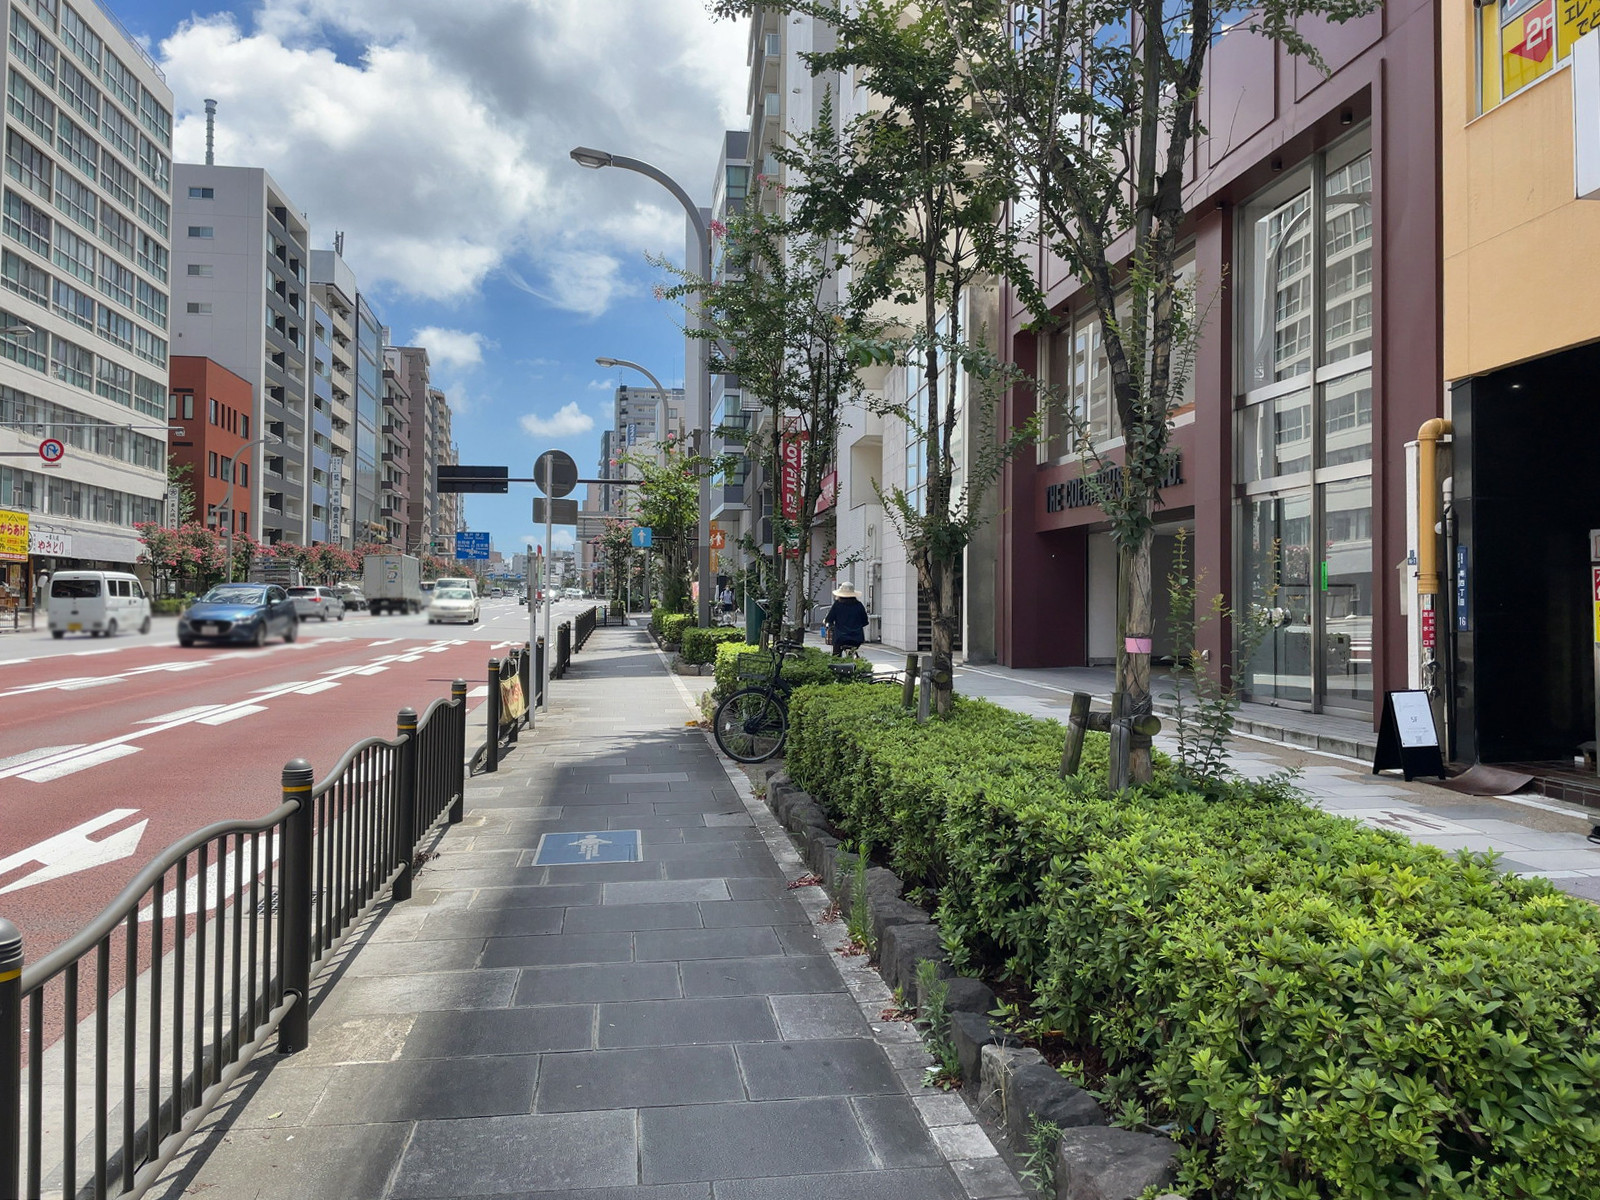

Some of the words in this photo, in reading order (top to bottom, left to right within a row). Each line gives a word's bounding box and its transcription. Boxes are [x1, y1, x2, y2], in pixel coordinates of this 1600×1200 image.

[1526, 13, 1553, 51] 2F
[37, 540, 64, 555] やきとり
[1459, 616, 1466, 626] 16
